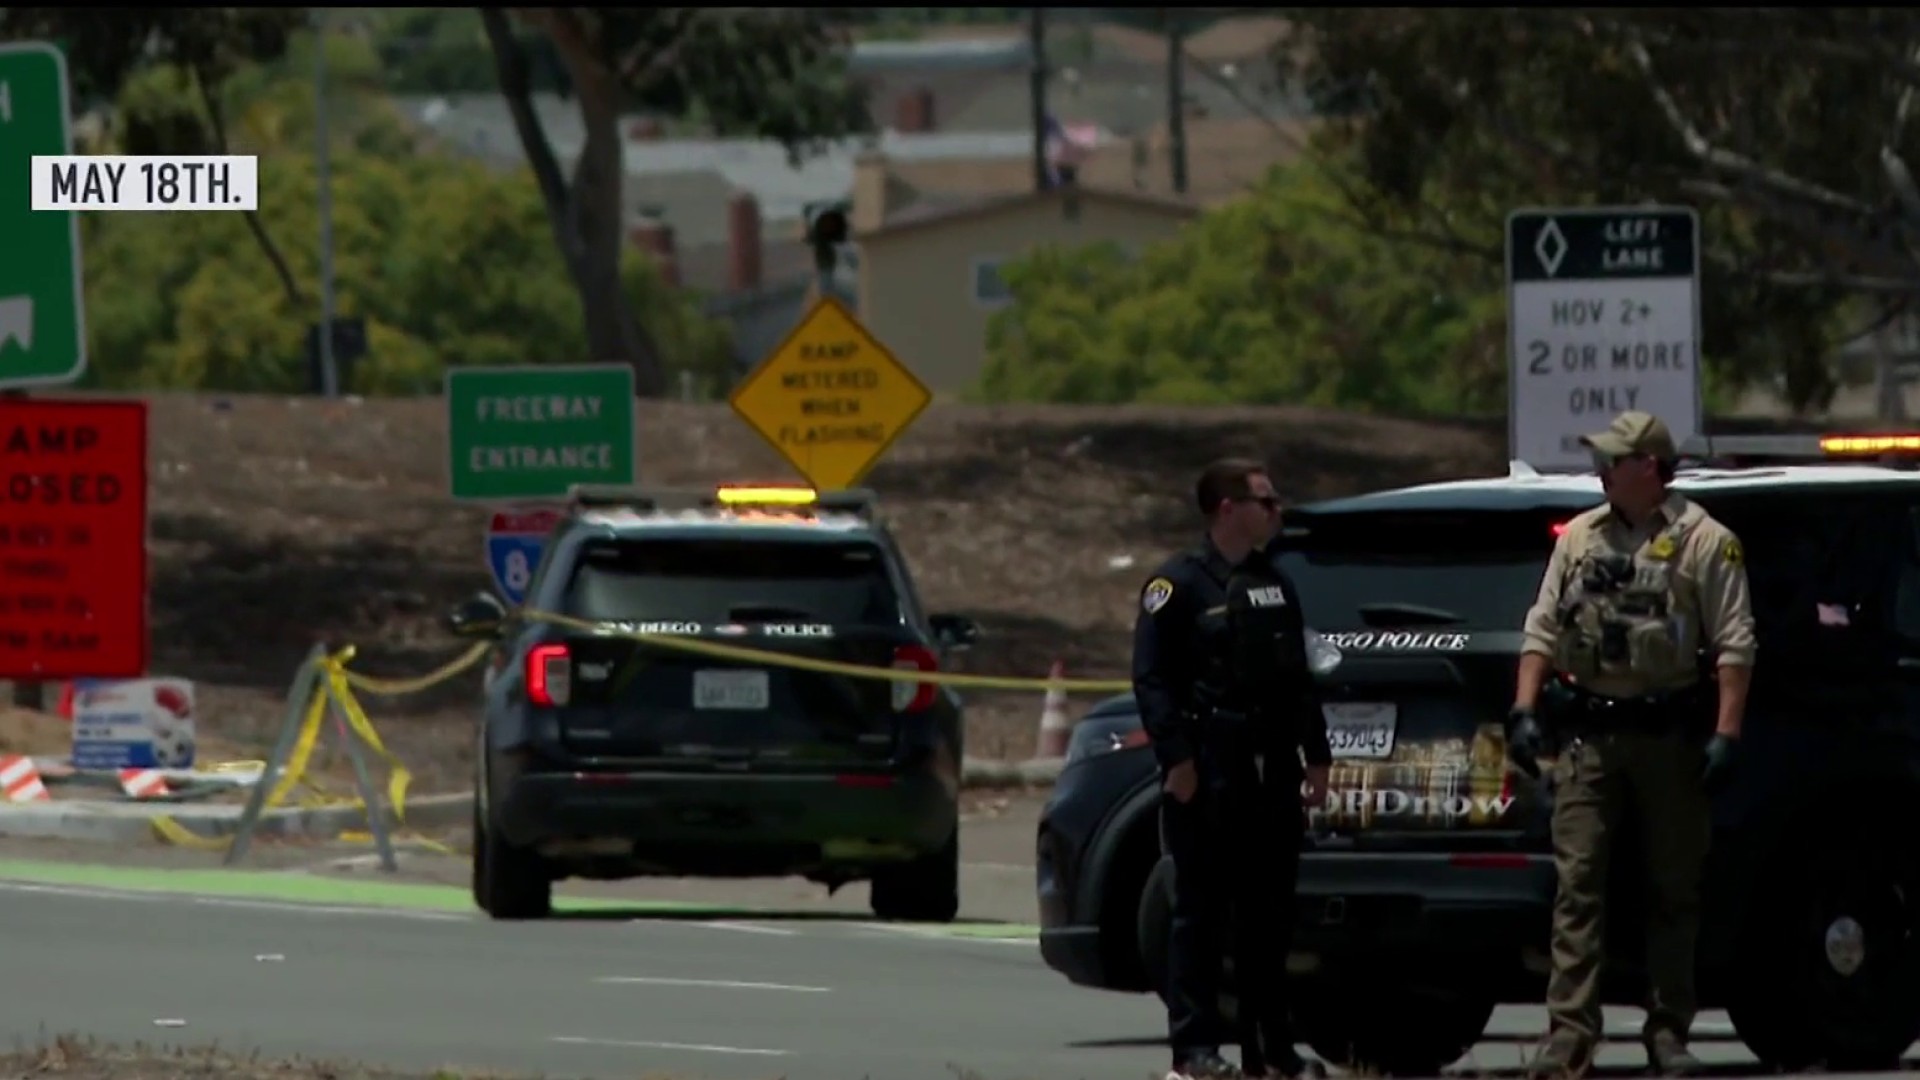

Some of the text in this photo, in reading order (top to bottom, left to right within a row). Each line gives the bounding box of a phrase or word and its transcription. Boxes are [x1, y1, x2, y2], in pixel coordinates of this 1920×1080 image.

[1605, 220, 1660, 241] LEFT
[1603, 248, 1662, 269] LANE
[1552, 299, 1652, 326] HOV 2+
[800, 342, 859, 361] RAMP
[1528, 340, 1686, 375] 2 OR MORE
[782, 369, 878, 389] METERED
[477, 396, 604, 421] FREEWAY
[801, 398, 860, 415] WHEN
[1570, 387, 1640, 415] ONLY
[471, 445, 612, 472] ENTRANCE
[0, 473, 122, 504] OSED
[504, 549, 530, 591] 8
[639, 621, 702, 635] DIEGO
[762, 622, 837, 638] POLICE
[1375, 631, 1470, 650] POLICE
